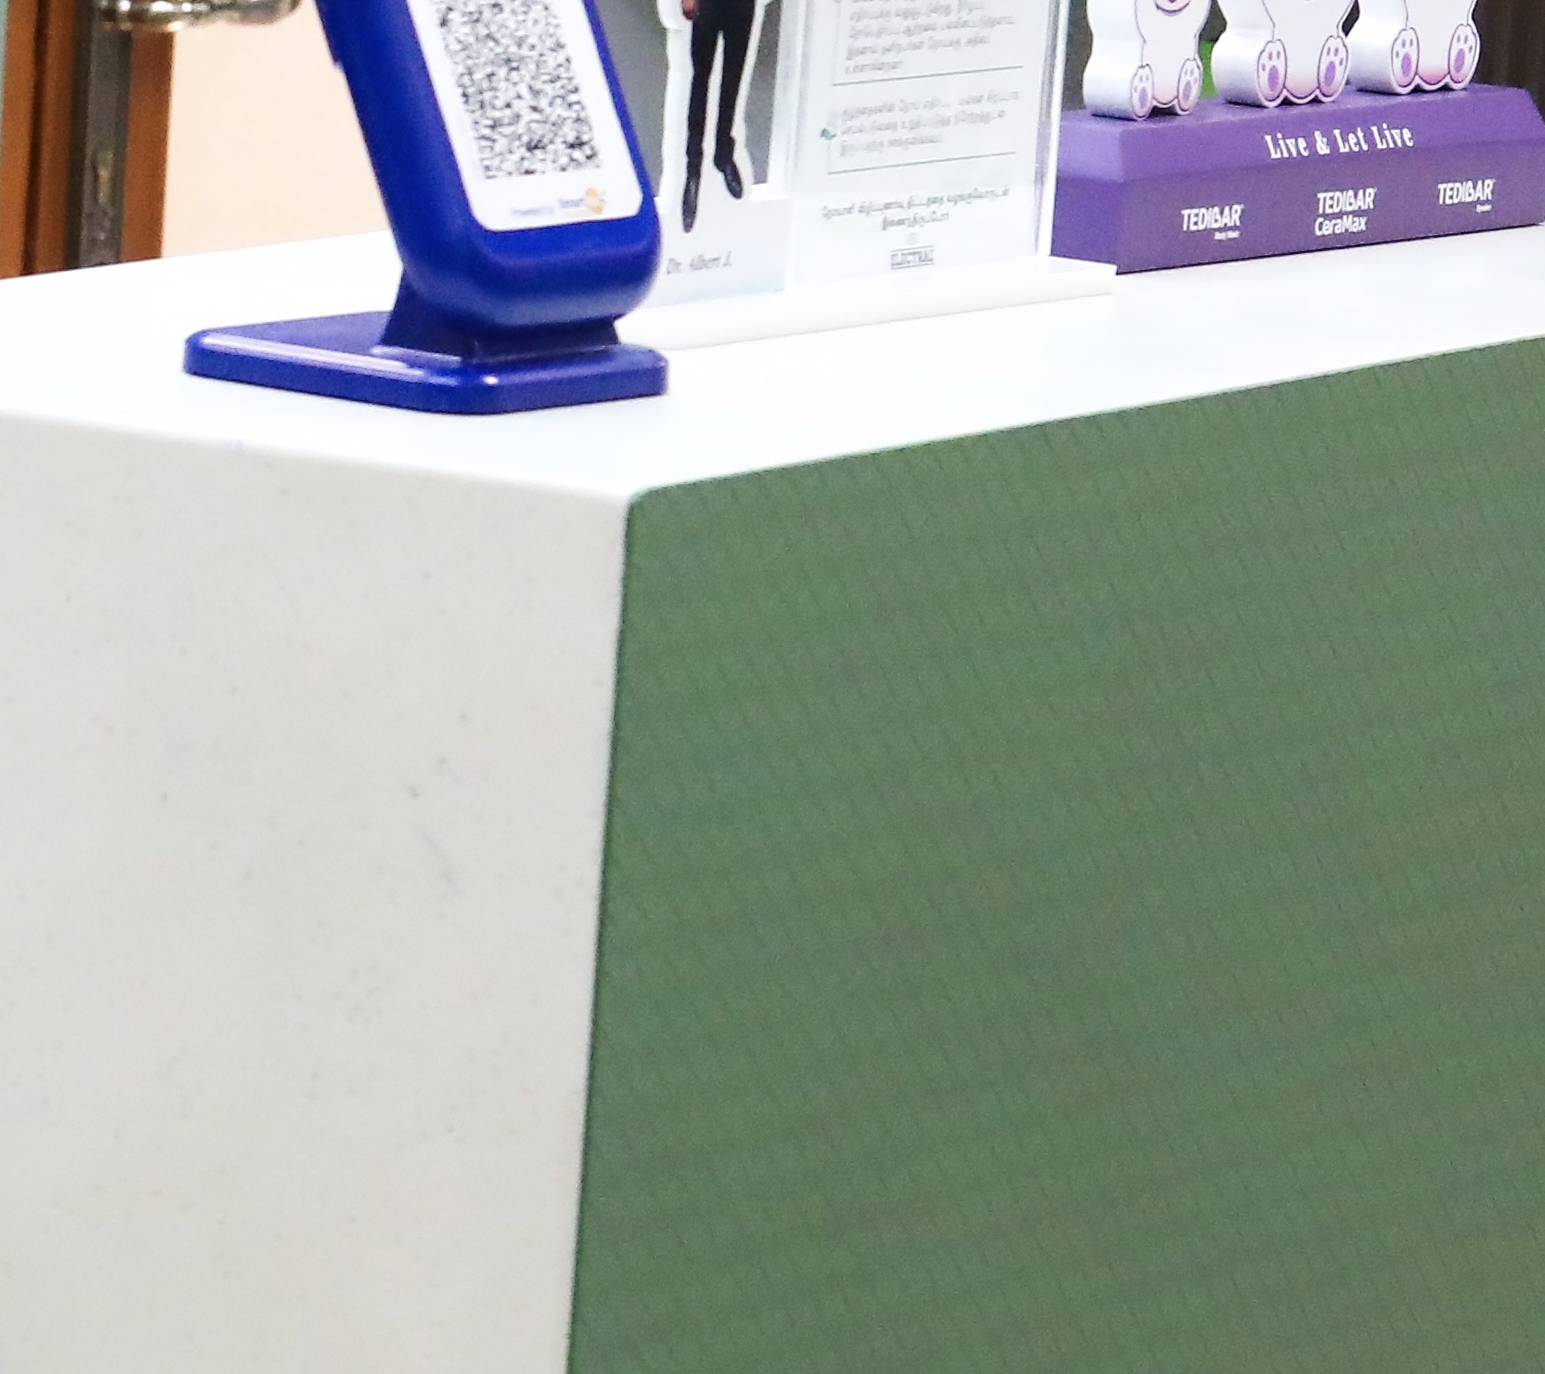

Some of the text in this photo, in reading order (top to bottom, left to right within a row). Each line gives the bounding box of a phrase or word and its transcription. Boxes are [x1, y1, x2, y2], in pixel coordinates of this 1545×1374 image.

[1264, 123, 1414, 159] Live & Let Live
[1317, 187, 1374, 214] TEDIBAR
[1438, 179, 1492, 204] TEDIBAR
[1181, 205, 1241, 231] TEDIBAR
[1314, 215, 1367, 236] CeraMax
